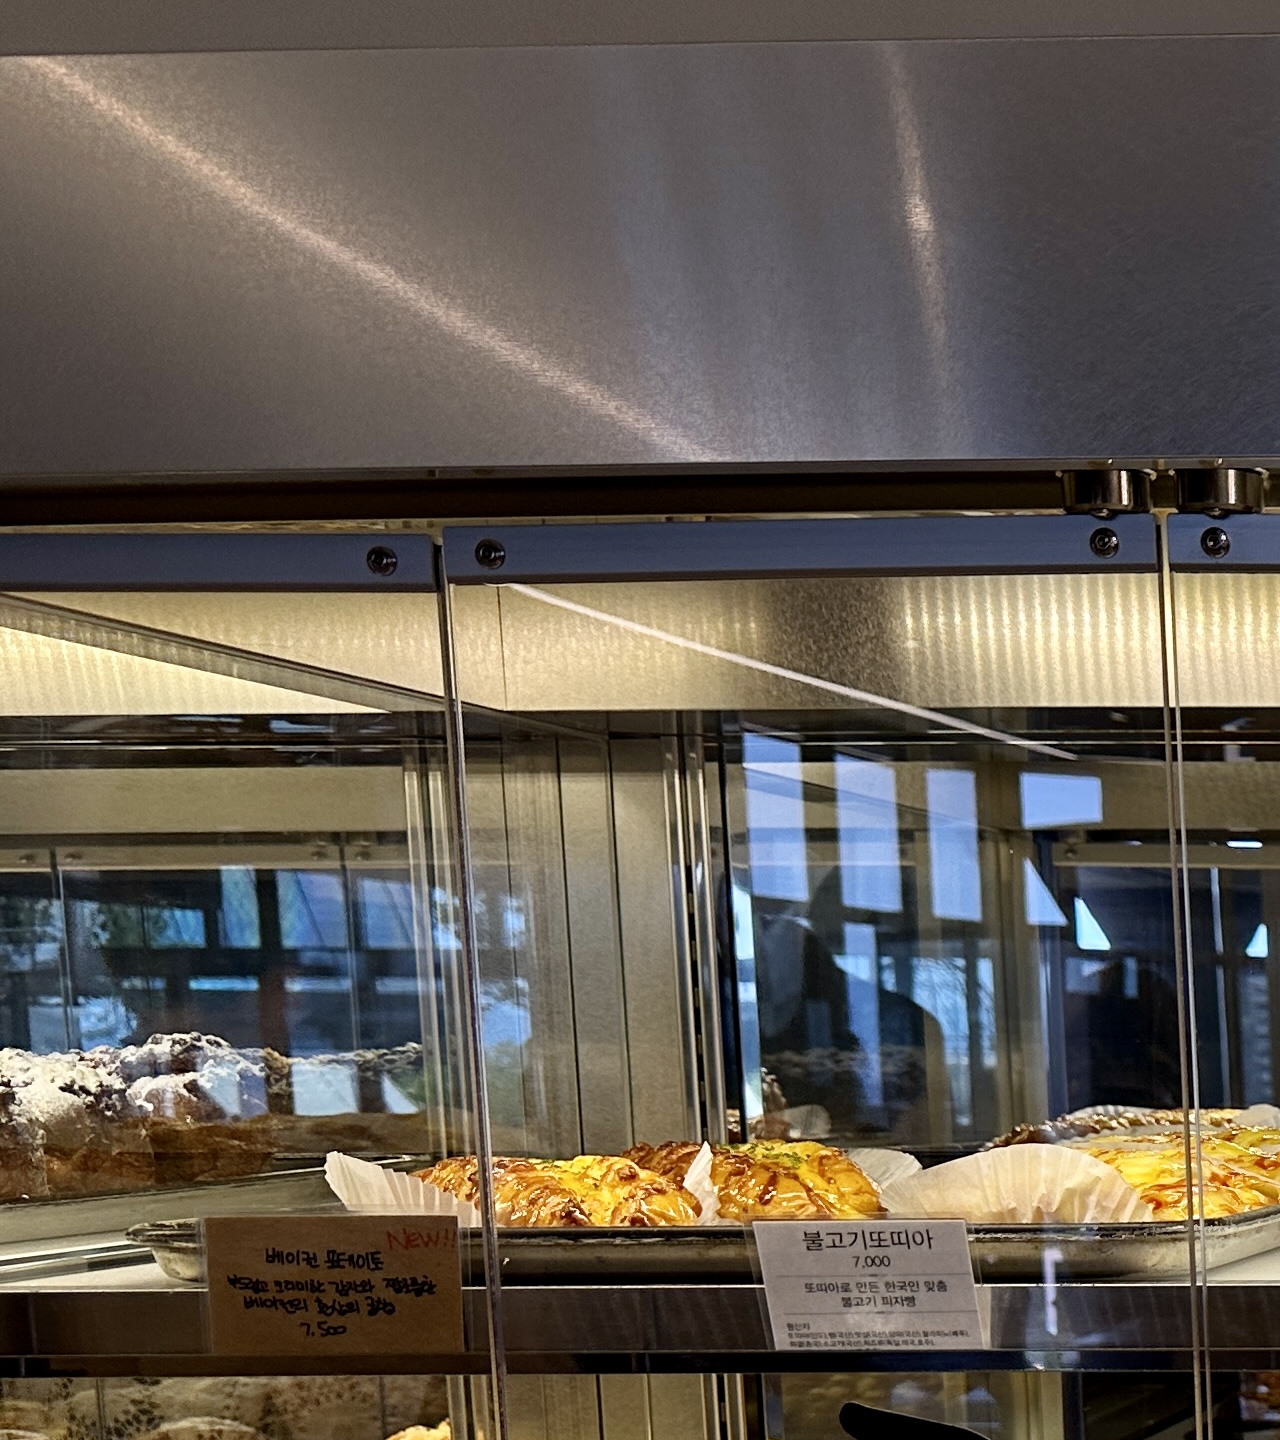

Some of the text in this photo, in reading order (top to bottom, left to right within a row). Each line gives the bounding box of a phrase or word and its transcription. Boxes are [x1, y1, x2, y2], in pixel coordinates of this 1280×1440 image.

[387, 1228, 458, 1250] NEW!!
[802, 1229, 933, 1251] 불고기또띠아
[852, 1256, 891, 1269] 7,000
[804, 1280, 949, 1294] 또띠아로 만든 한국인 맞춤
[841, 1295, 916, 1308] 불고기 피자빵
